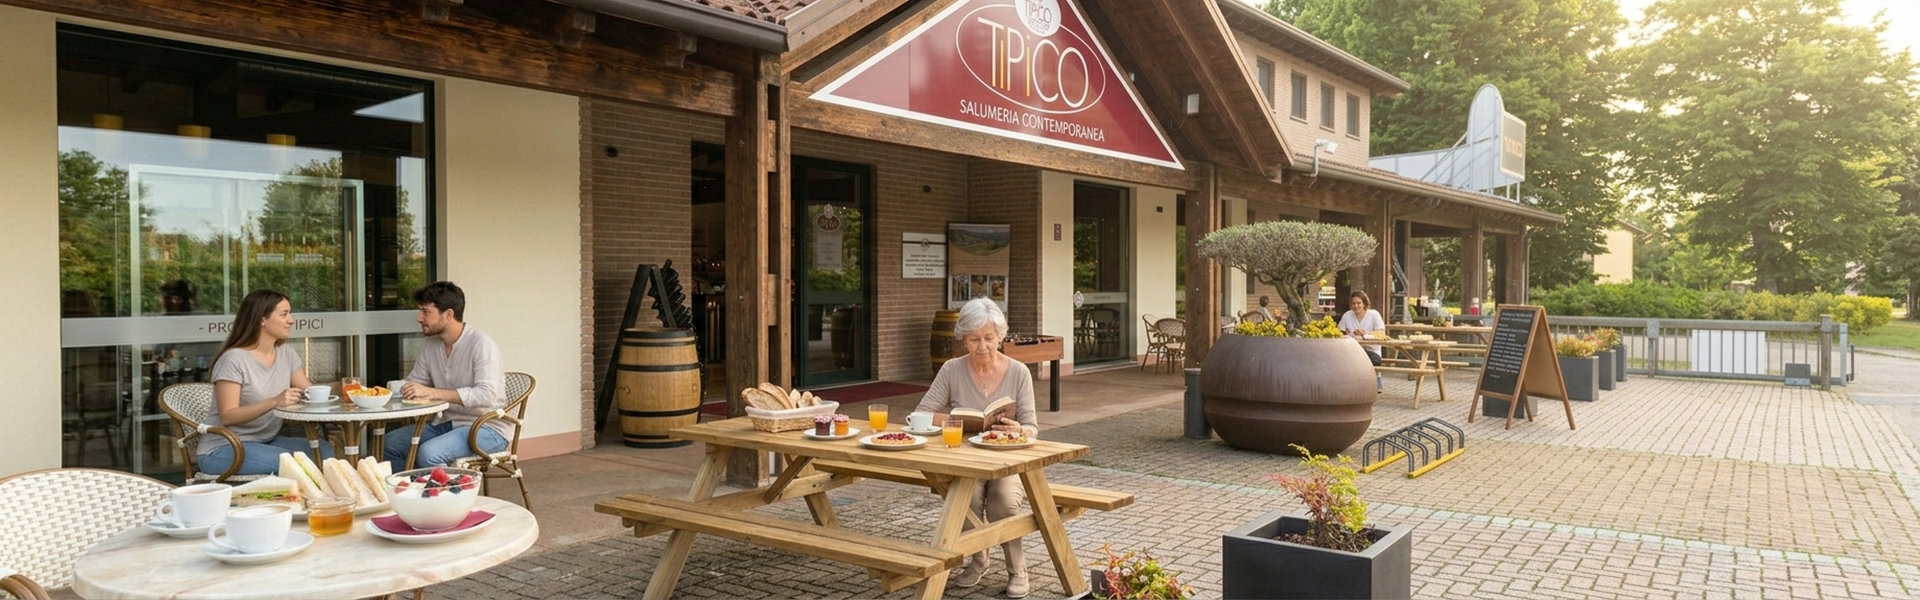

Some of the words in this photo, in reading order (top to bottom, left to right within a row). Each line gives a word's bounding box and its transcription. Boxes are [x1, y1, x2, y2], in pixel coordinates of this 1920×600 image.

[960, 99, 1019, 125] SALUMERIA
[1022, 113, 1105, 142] CONTEMPORANEA
[208, 322, 235, 333] PRO
[295, 318, 324, 331] IPICI
